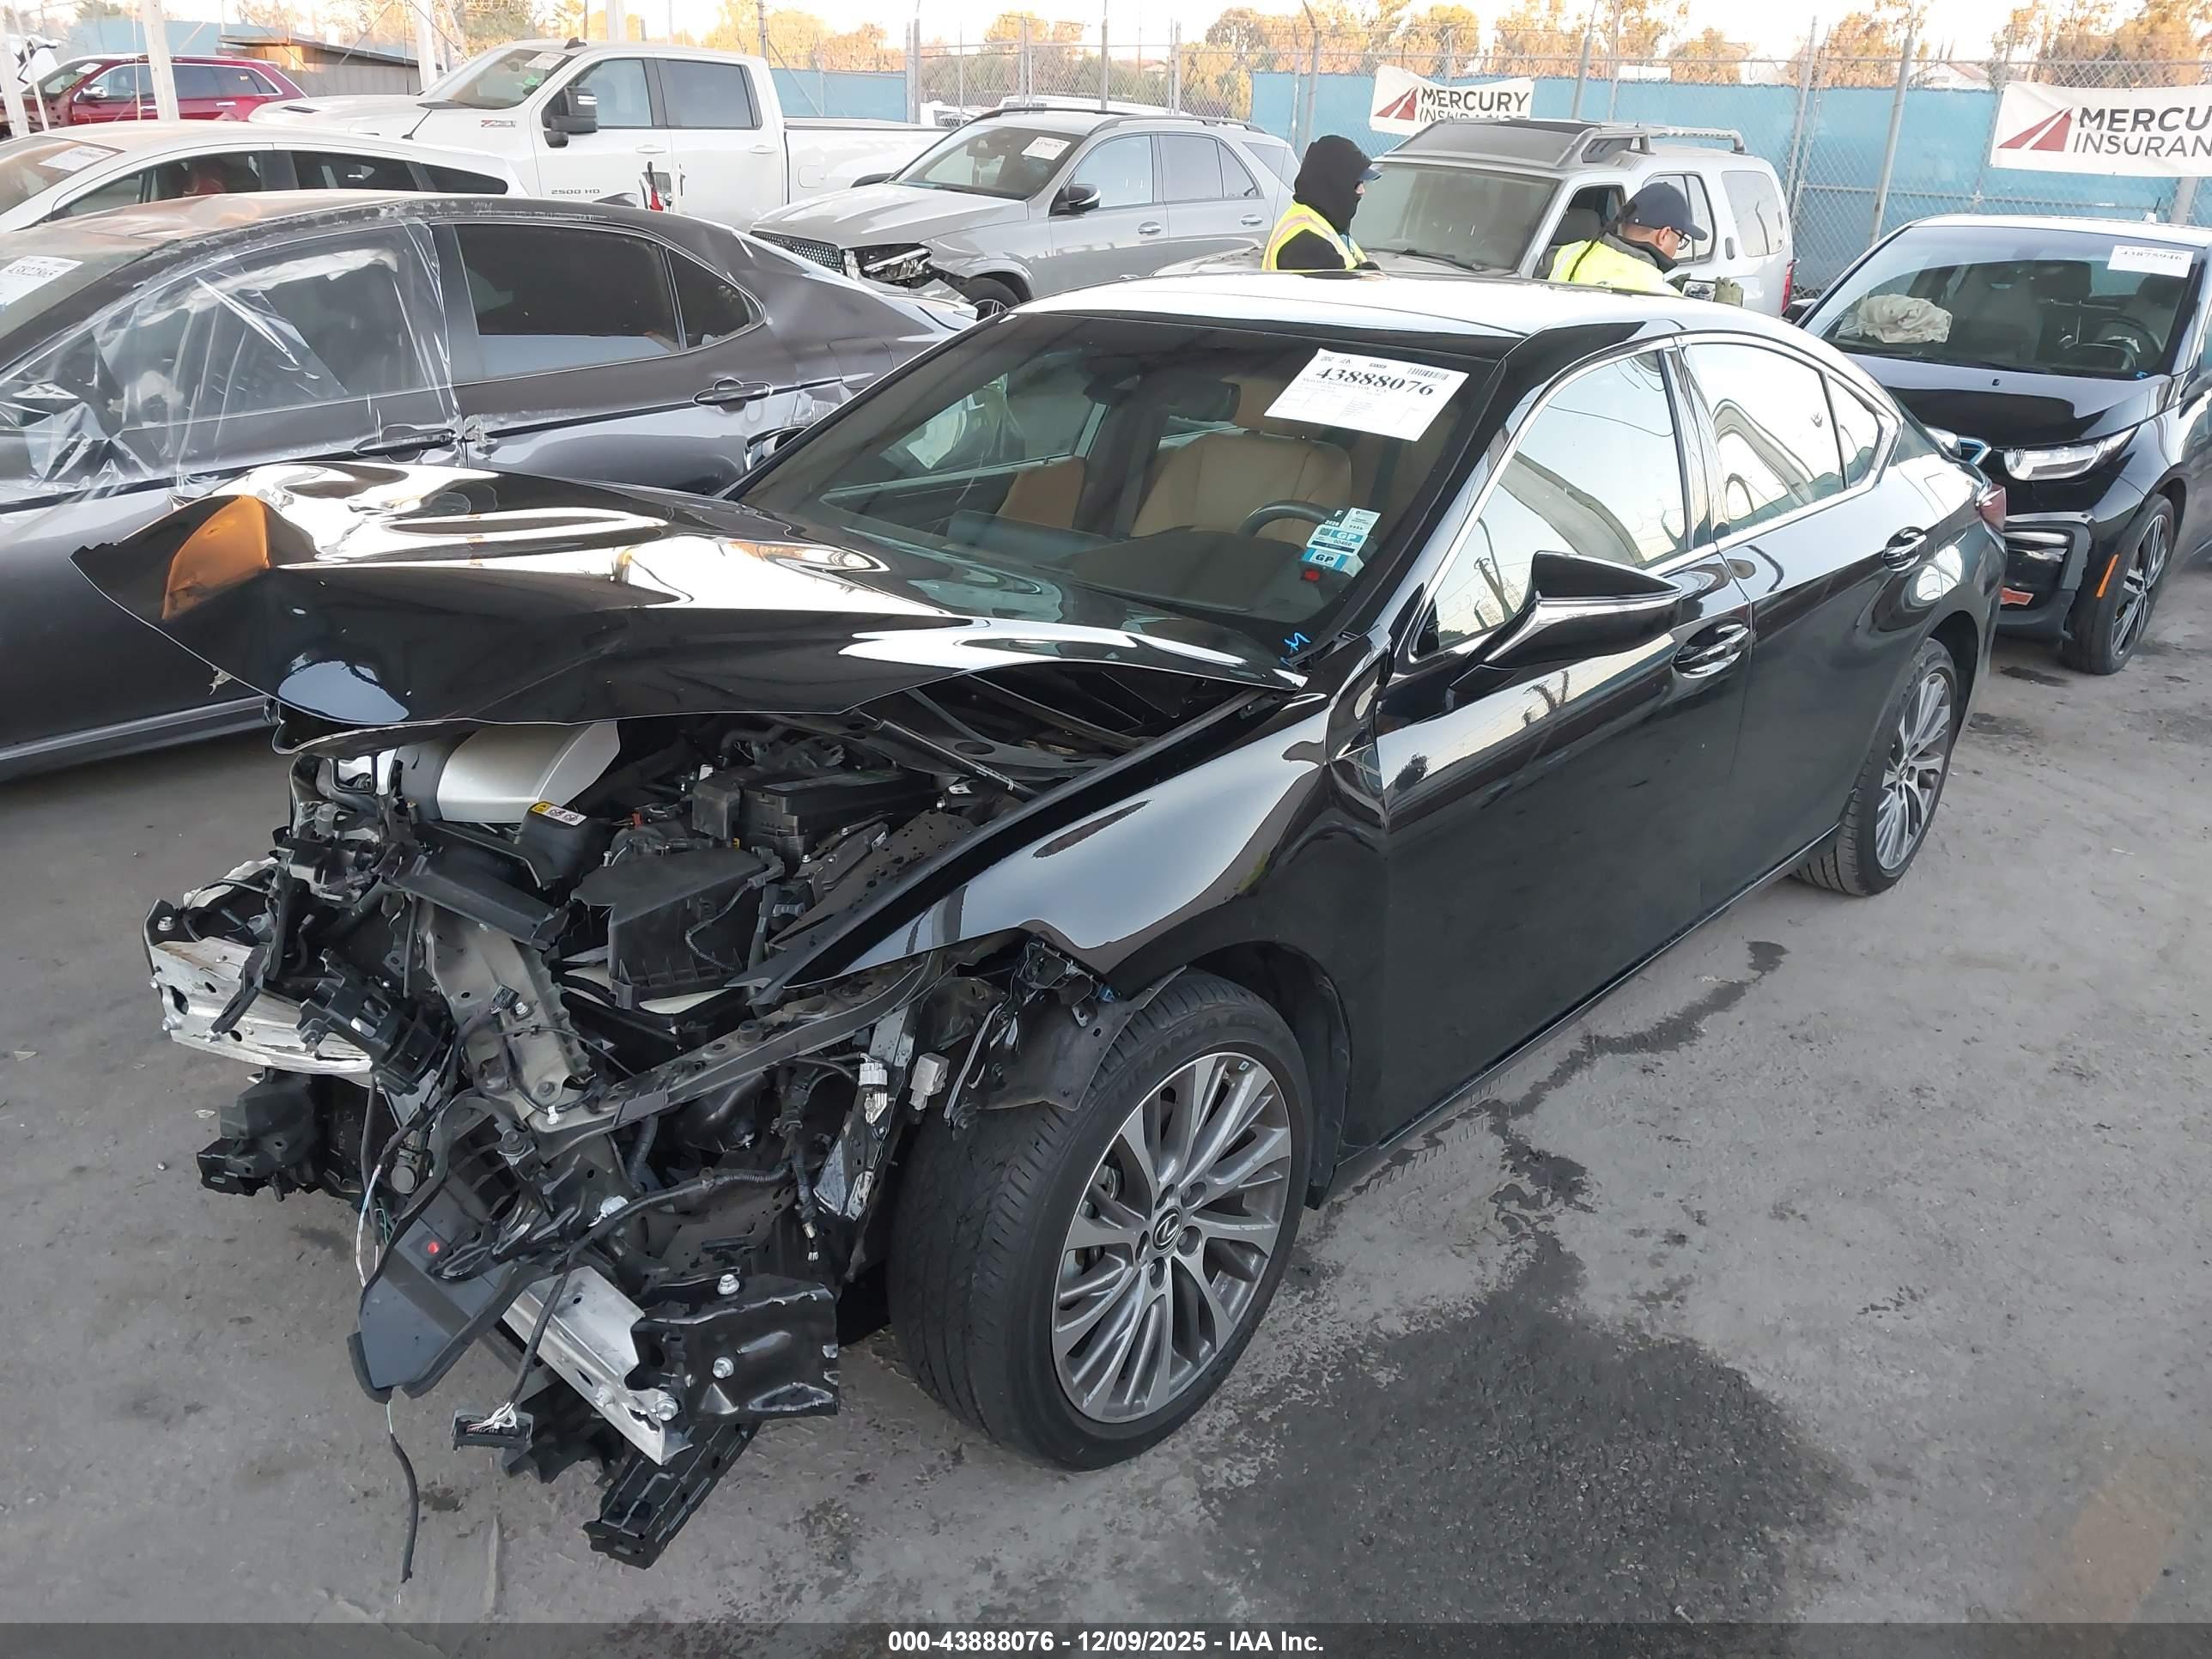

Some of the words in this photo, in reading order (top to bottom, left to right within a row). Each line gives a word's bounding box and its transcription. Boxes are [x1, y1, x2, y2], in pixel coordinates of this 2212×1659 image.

[1421, 86, 1530, 112] MERCURY
[1316, 367, 1438, 397] 43888076
[1336, 532, 1358, 541] GP
[1316, 553, 1334, 563] GP
